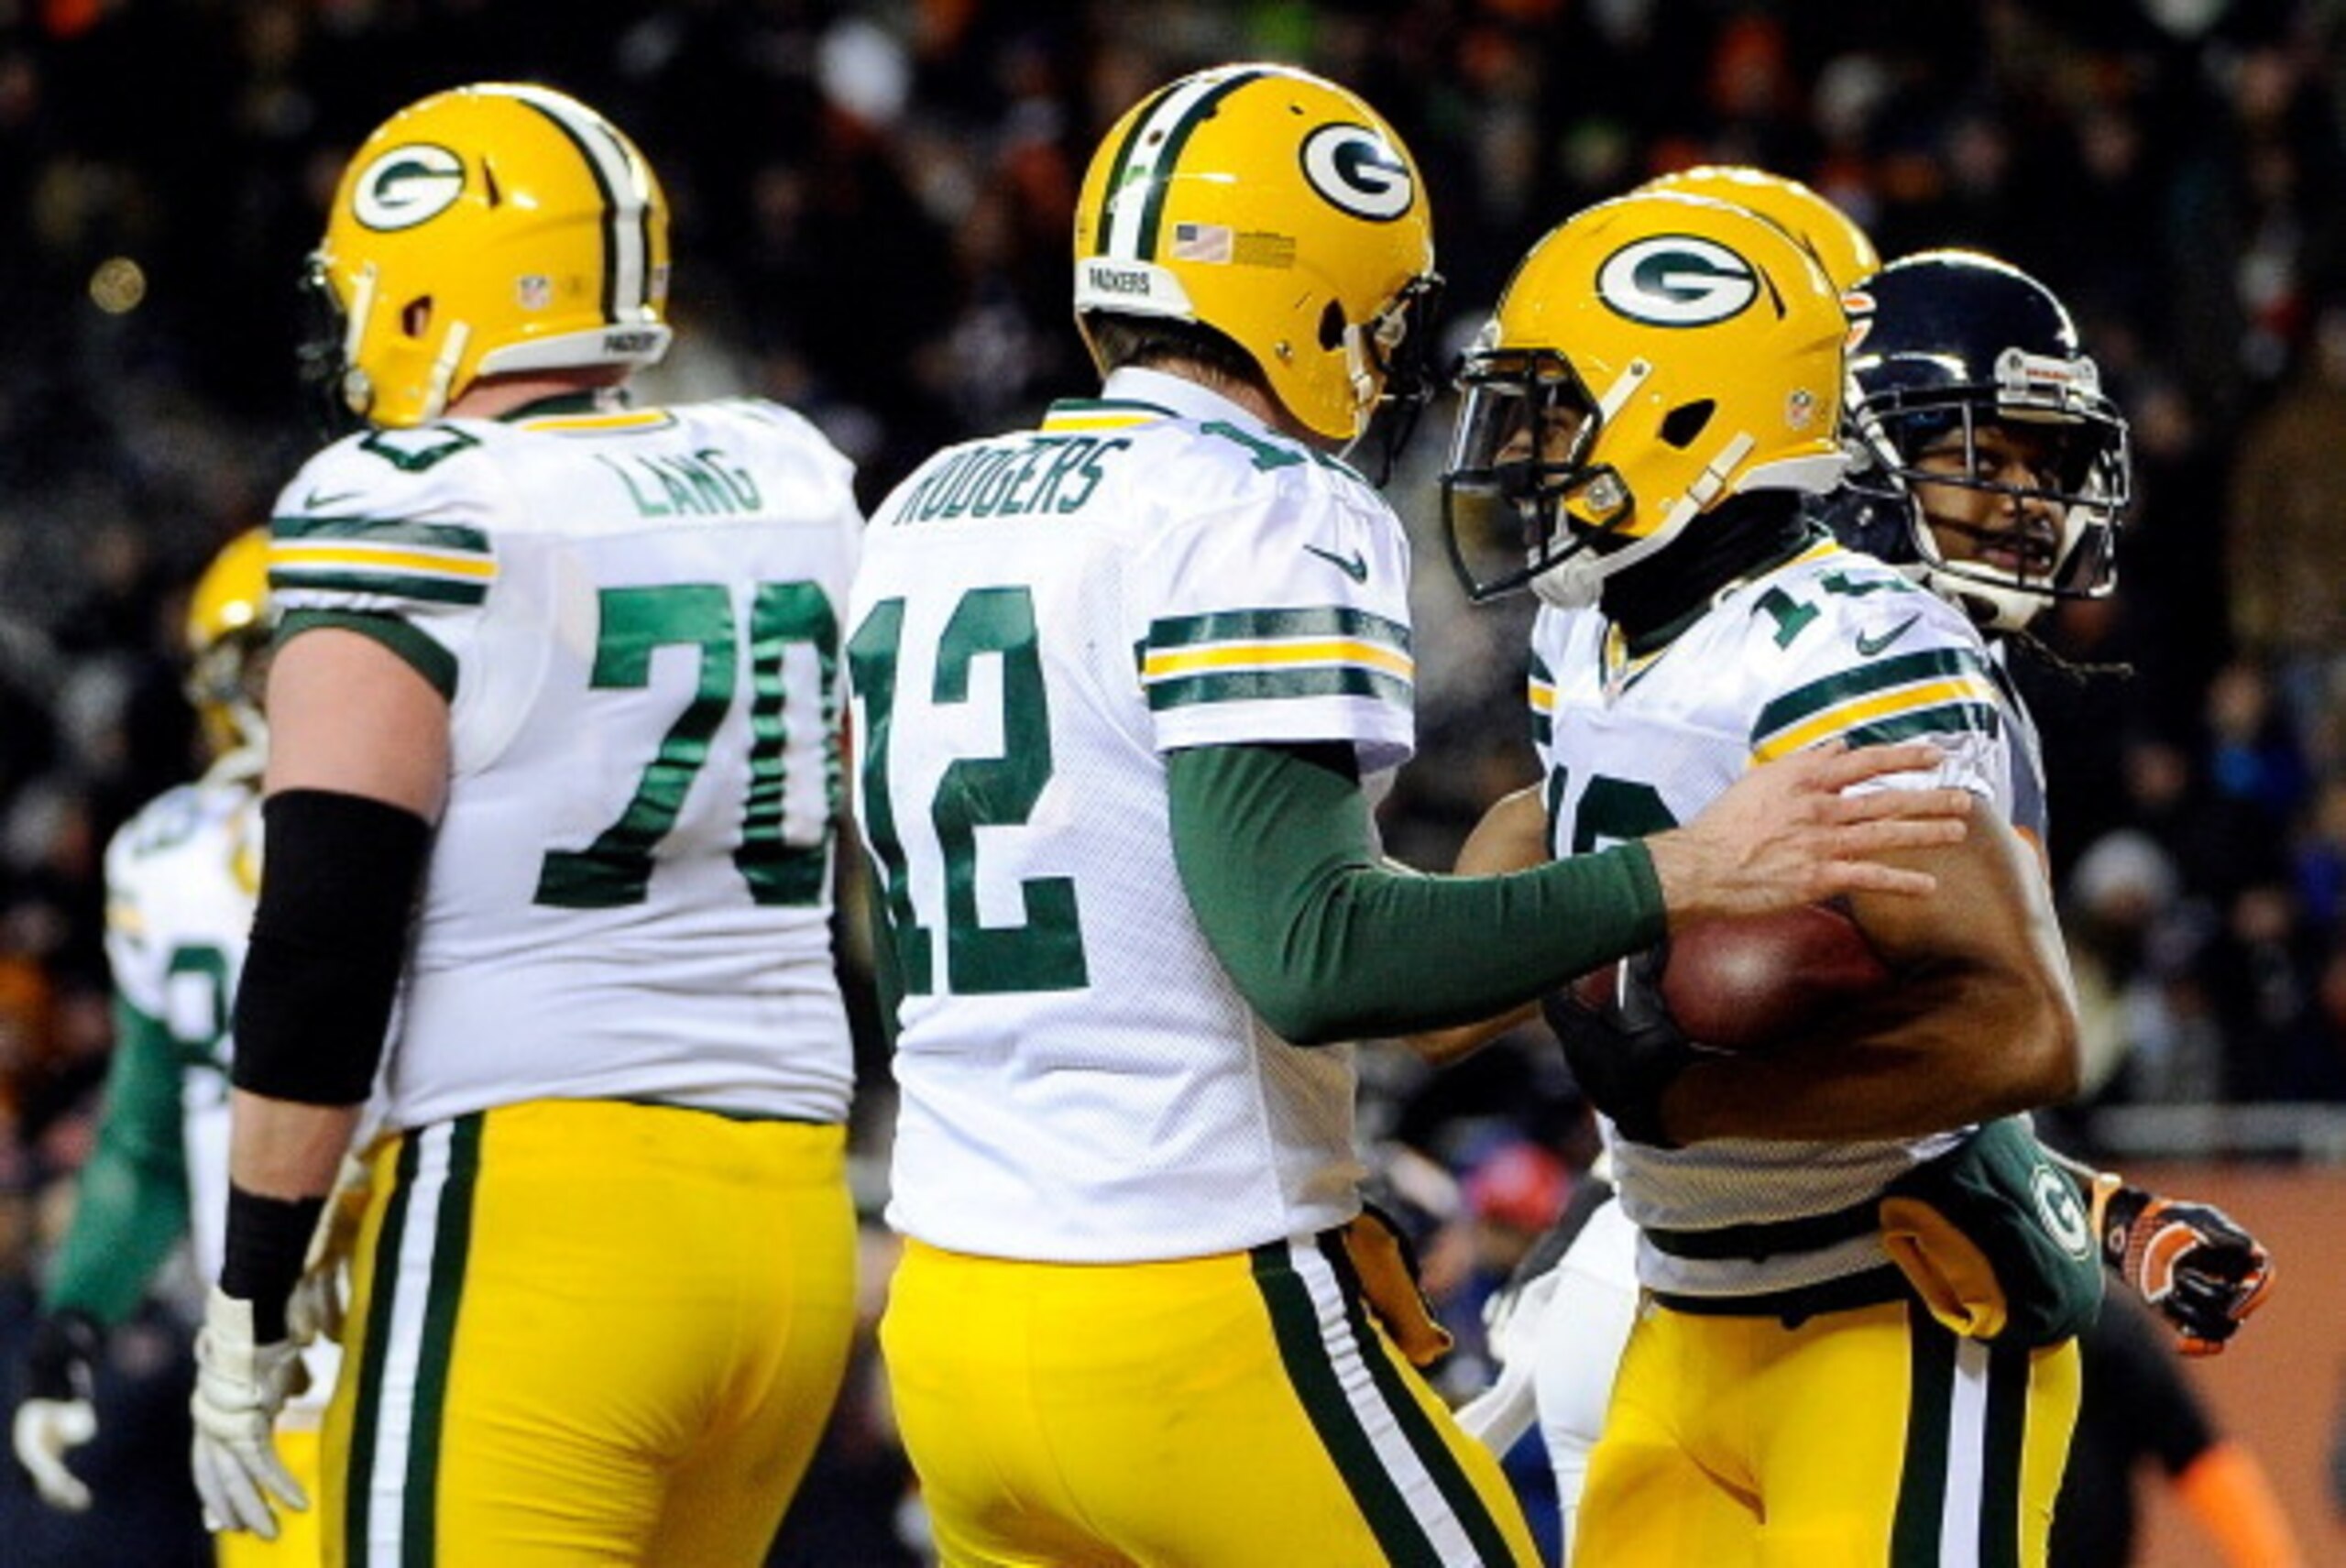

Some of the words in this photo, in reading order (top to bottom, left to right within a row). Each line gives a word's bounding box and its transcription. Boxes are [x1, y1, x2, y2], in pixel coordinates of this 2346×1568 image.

[1595, 234, 1759, 328] G
[594, 449, 761, 517] LANG
[891, 437, 1135, 521] RODGERS
[532, 580, 841, 907] 70
[847, 585, 1090, 995] 12
